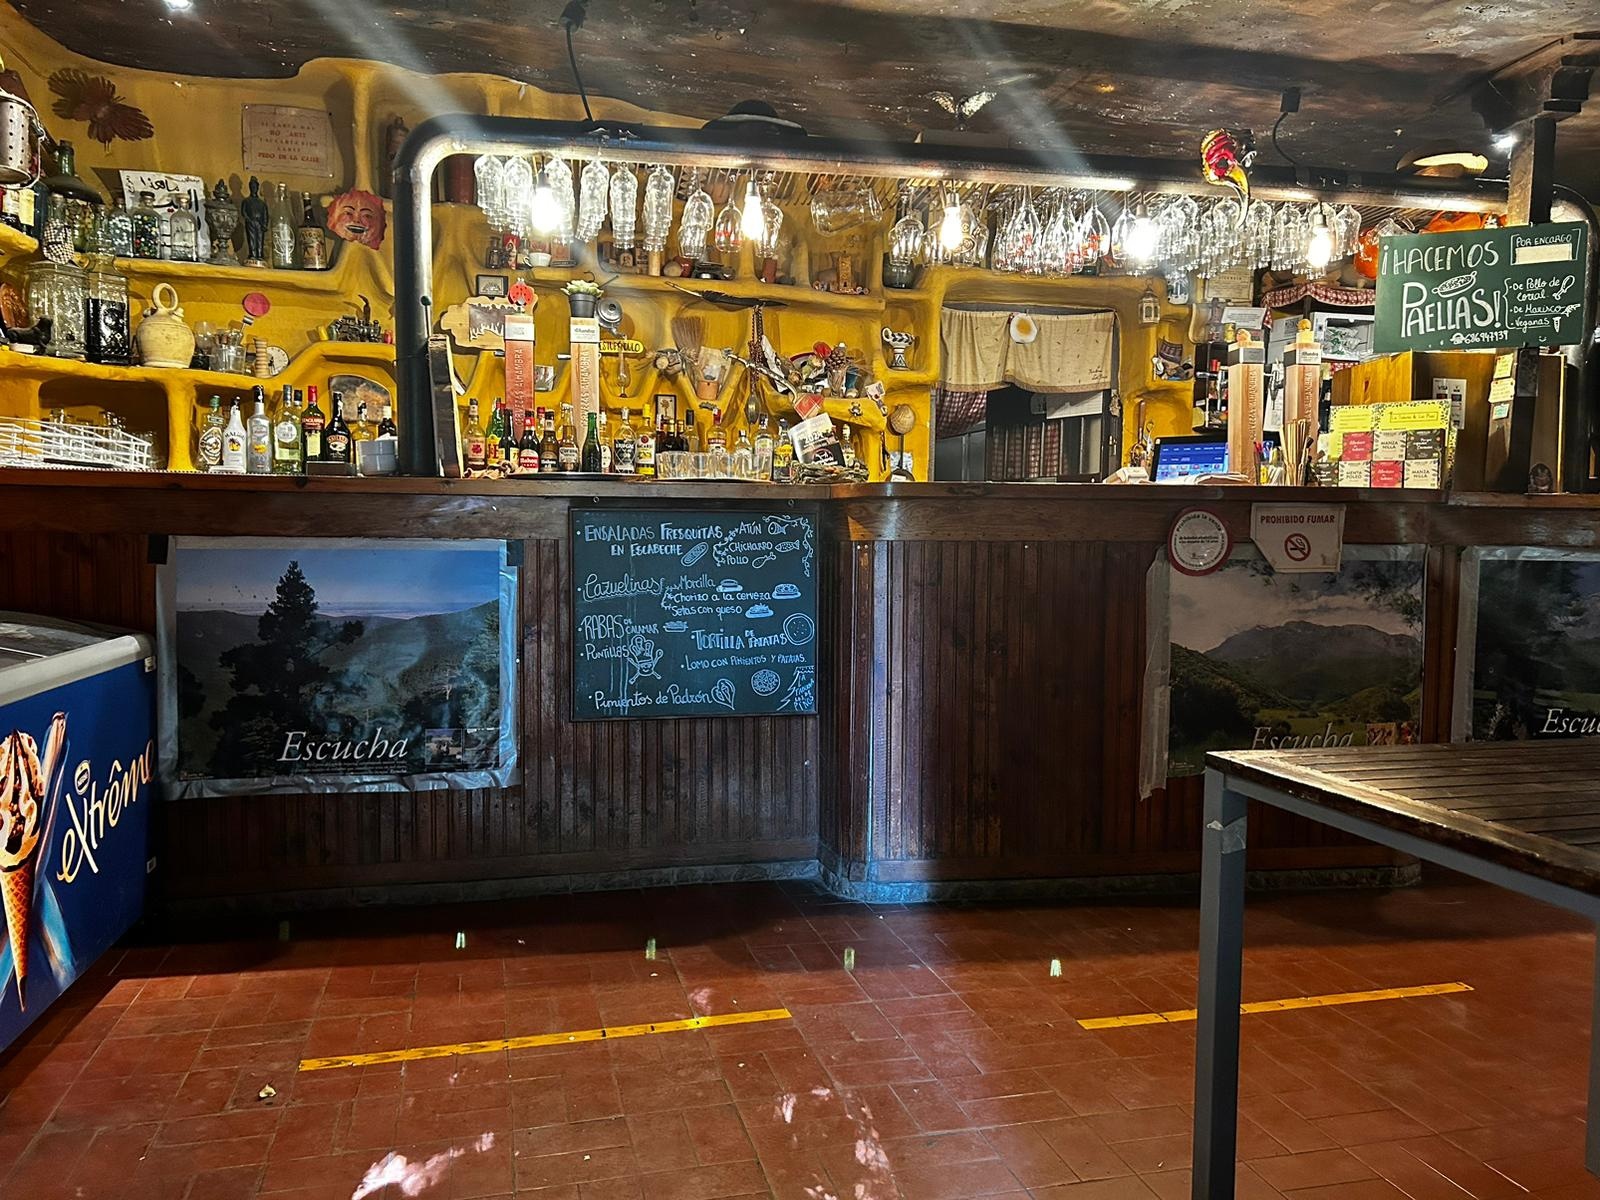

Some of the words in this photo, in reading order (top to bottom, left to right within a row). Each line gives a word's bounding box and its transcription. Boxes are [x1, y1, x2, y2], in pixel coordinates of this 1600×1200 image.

[1516, 236, 1532, 247] POR
[1526, 277, 1547, 290] Pollo
[1548, 276, 1561, 288] de
[1401, 281, 1501, 338] PAELLAS!
[514, 348, 524, 387] ALHAMBRA
[580, 350, 591, 390] ALHAMBRA
[1260, 515, 1305, 524] PROHIBIDO
[1306, 515, 1335, 524] FUMAR
[584, 525, 656, 541] ENSALADAS
[660, 522, 723, 540] FRESQUITAS
[739, 521, 762, 535] ATÚN
[611, 544, 625, 556] EN
[630, 543, 683, 557] ESCABECHE
[726, 555, 749, 565] POLLO
[680, 574, 716, 590] Morcilla
[674, 592, 708, 604] Chorizo
[722, 592, 735, 601] la
[736, 591, 772, 601] cerveza
[671, 605, 697, 617] Setas
[697, 605, 713, 614] con
[715, 605, 743, 621] queso
[581, 615, 624, 640] RABAS
[744, 629, 755, 638] DE
[691, 628, 745, 650] TORTILLA
[748, 634, 788, 649] PATATAS
[685, 655, 710, 671] LOMO
[711, 657, 729, 669] CON
[770, 654, 777, 663] Y
[594, 690, 653, 710] Pimientos
[655, 690, 669, 704] de
[1251, 721, 1354, 750] Escucha
[276, 727, 409, 762] Escucha
